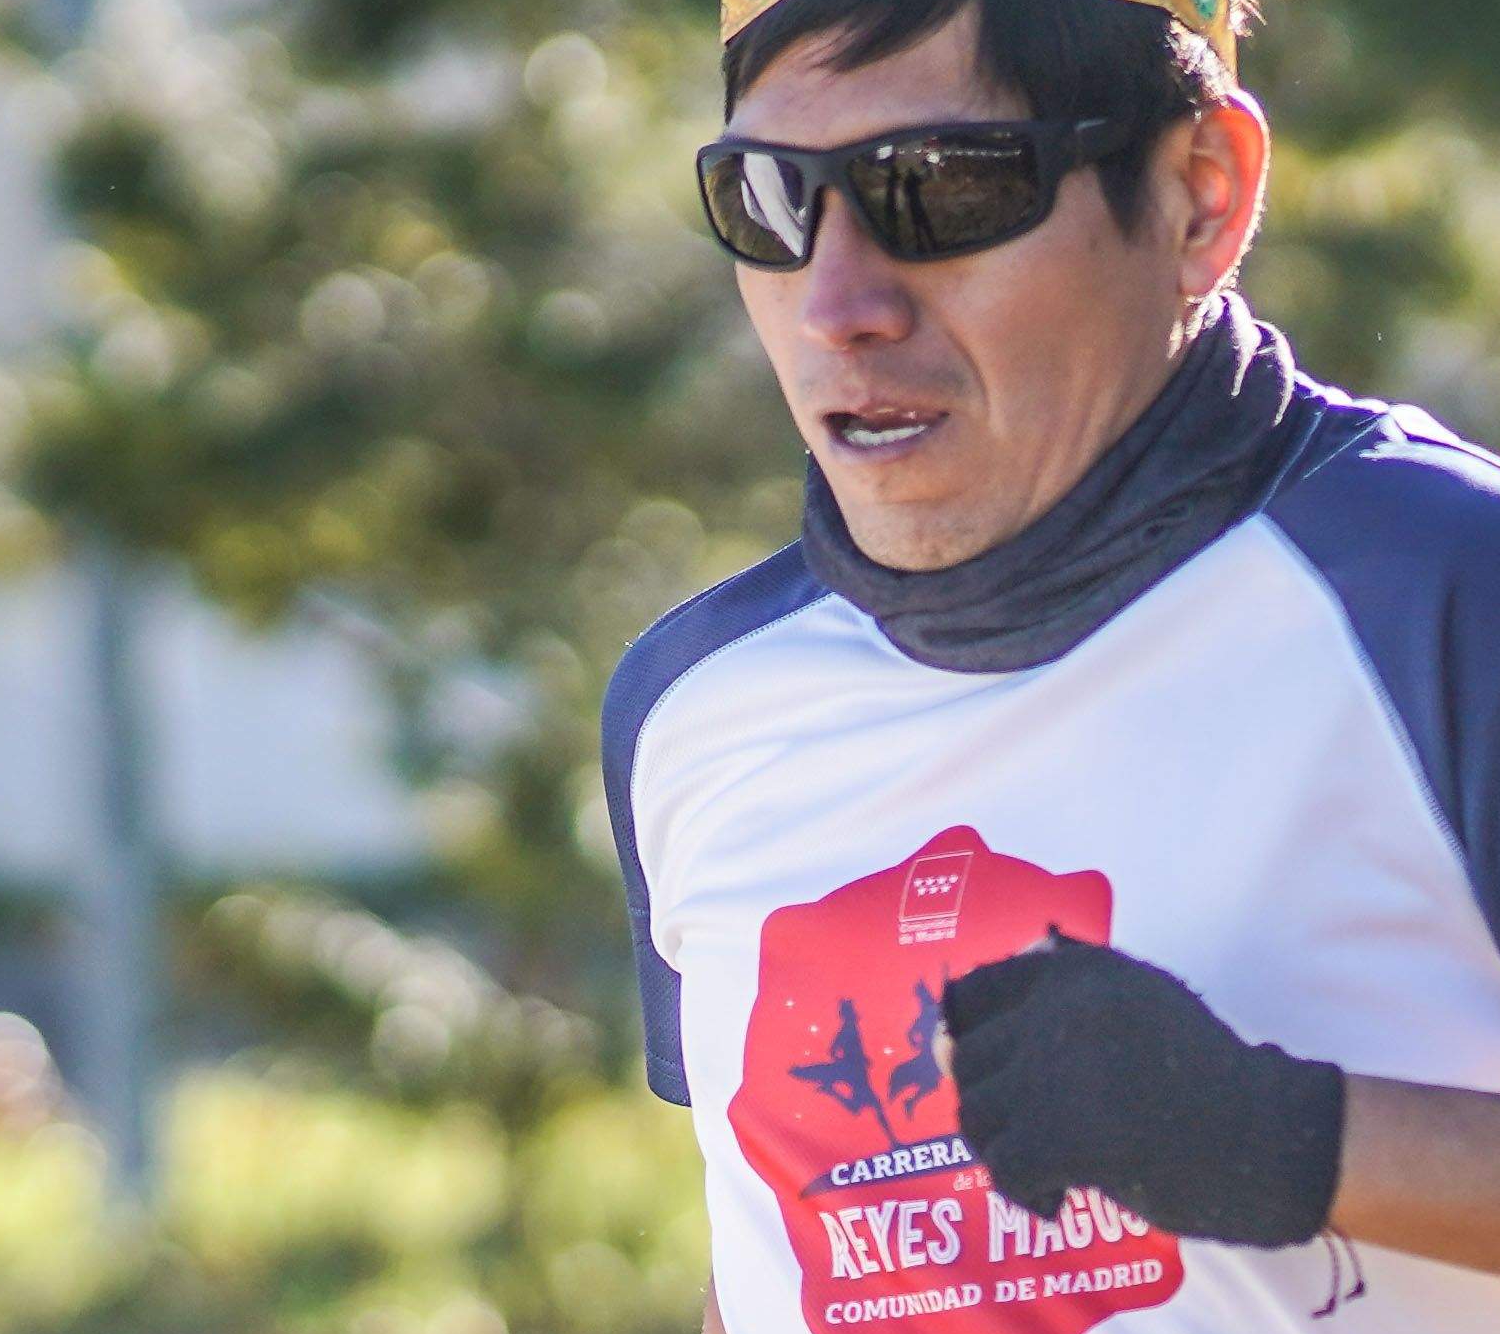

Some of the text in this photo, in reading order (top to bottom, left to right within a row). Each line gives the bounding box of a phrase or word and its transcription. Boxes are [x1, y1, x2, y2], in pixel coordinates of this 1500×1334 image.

[831, 1137, 973, 1186] CARRERA
[953, 1170, 973, 1191] de
[819, 1197, 963, 1280] REYES
[825, 1259, 1163, 1325] COMUNIDAD DE MADRID
